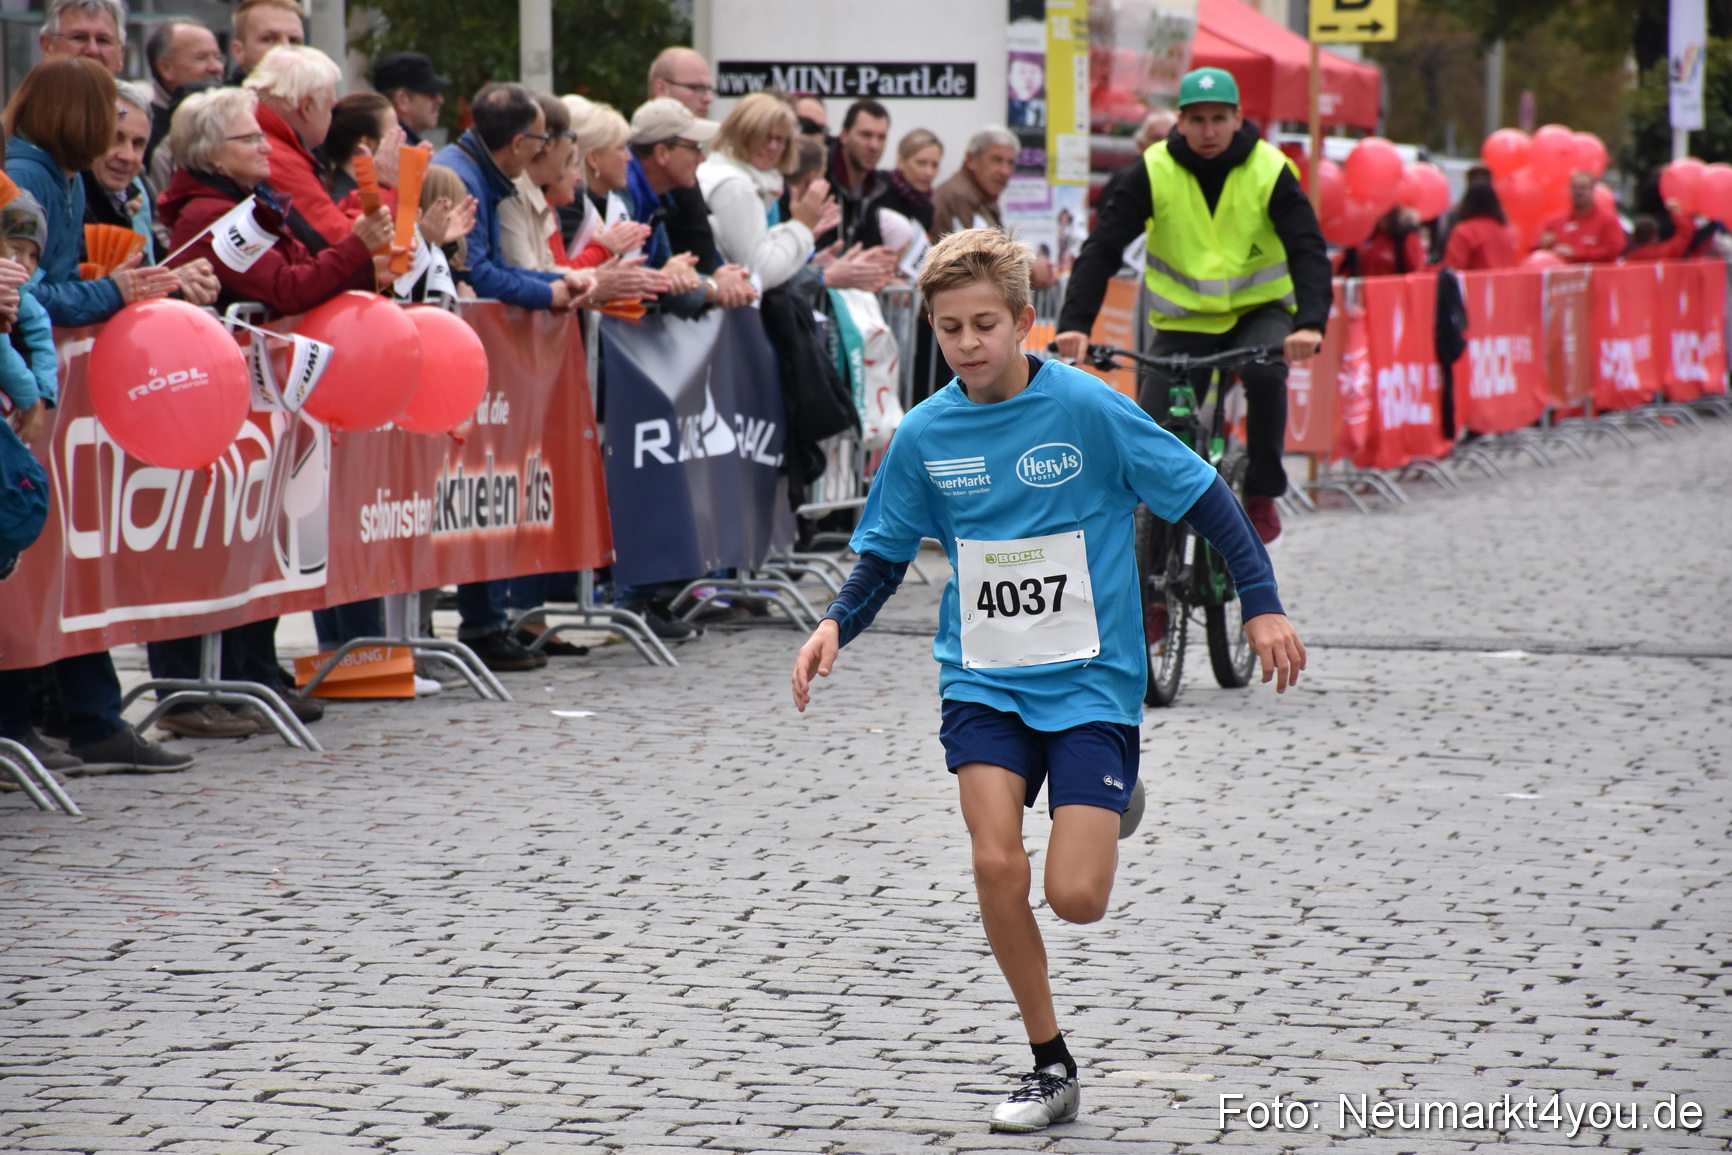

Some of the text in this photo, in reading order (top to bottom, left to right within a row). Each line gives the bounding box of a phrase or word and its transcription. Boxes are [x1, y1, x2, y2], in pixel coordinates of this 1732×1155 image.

[718, 65, 967, 95] www.MINI-Partl.de
[170, 379, 209, 393] energie
[1023, 452, 1079, 476] Hervis
[929, 474, 992, 489] uerMarkt
[1029, 473, 1056, 482] SPORTS
[997, 548, 1045, 564] BOCK
[977, 574, 1067, 619] 4037
[309, 648, 384, 671] WBUNG
